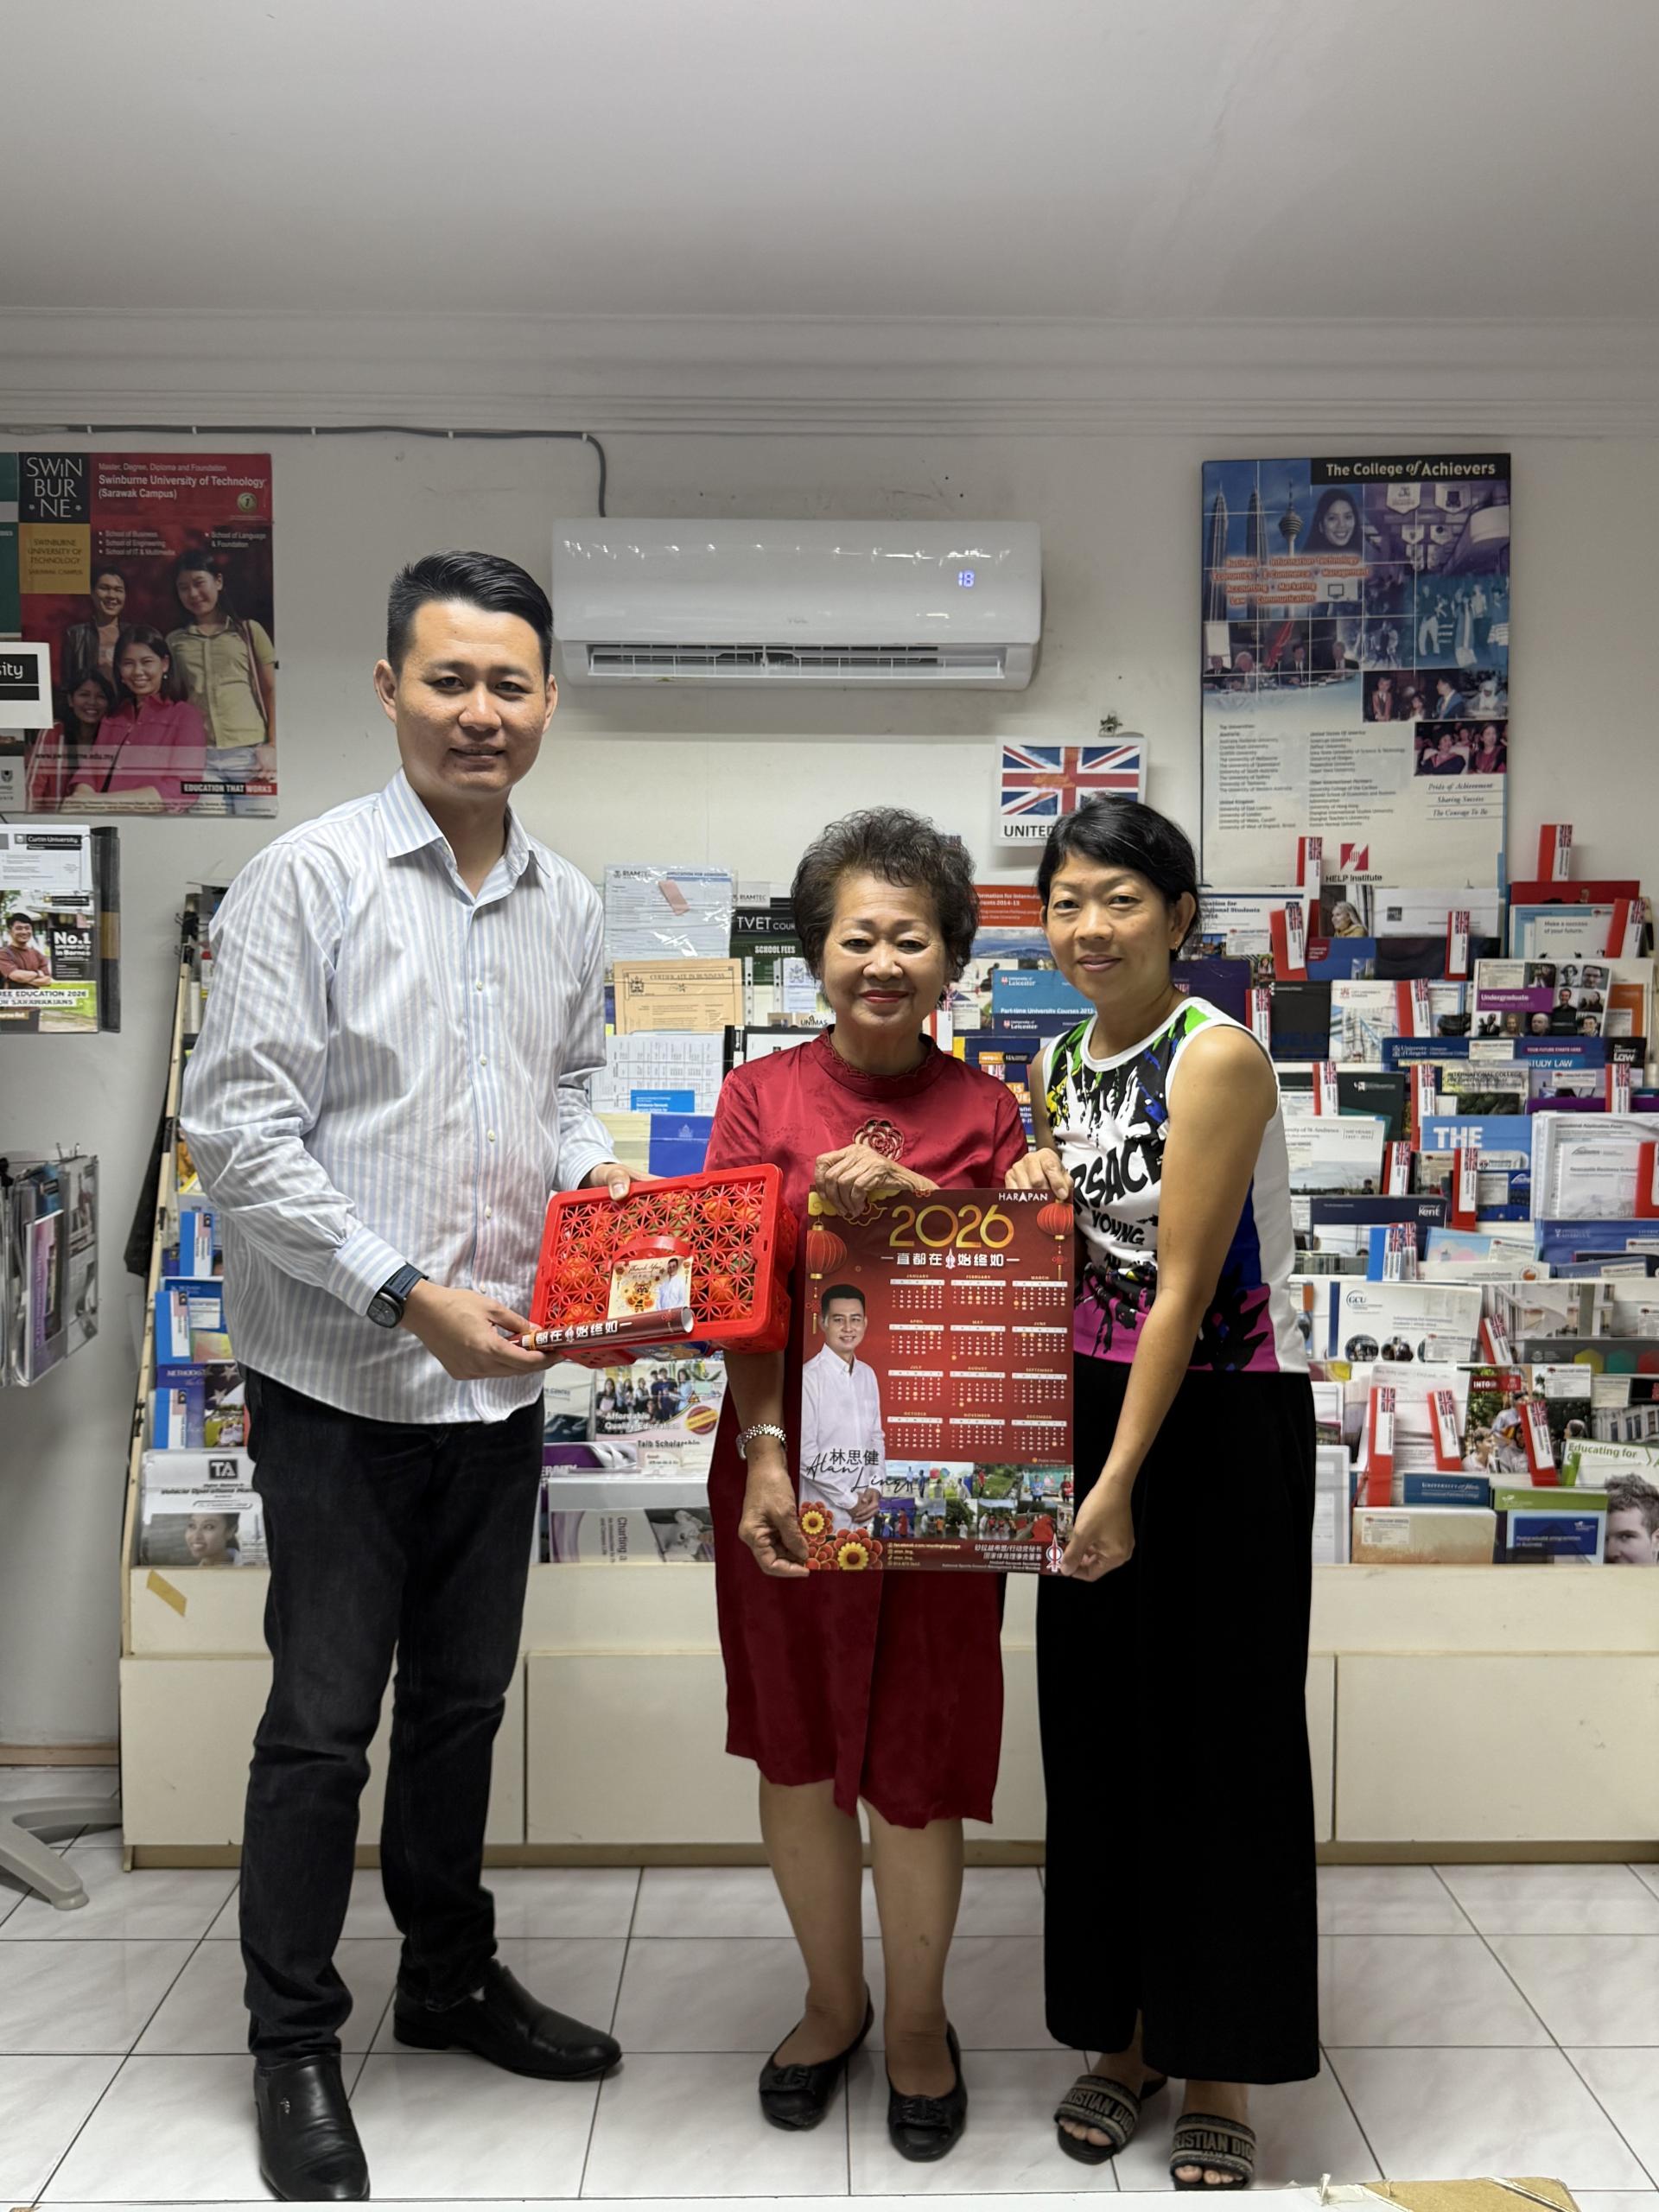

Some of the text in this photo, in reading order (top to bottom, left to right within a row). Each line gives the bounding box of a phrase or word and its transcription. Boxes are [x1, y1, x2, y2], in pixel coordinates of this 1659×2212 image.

[1326, 460, 1496, 476] The College of Achievers
[99, 474, 264, 488] Swinburne University of Technology
[35, 479, 77, 498] BUR
[99, 488, 176, 500] (Sarawak Campus)
[41, 499, 71, 517] NE
[34, 538, 76, 547] SWINBURNE
[30, 556, 79, 565] TECHNOLOGY
[958, 571, 975, 587] 18
[184, 784, 272, 793] EDUCATION THAT WORKS
[1004, 824, 1054, 837] UNITED
[1351, 874, 1382, 882] Institute
[737, 916, 772, 931] TVET
[54, 931, 92, 944] No.1
[754, 945, 796, 954] SCHOOL FEES
[1481, 994, 1529, 1002] Undergraduate
[1554, 1059, 1573, 1068] LAW
[1433, 1126, 1483, 1148] THE
[998, 1192, 1048, 1202] HARAPAN
[1419, 1208, 1440, 1217] Kent
[889, 1205, 1014, 1249] 2026
[605, 1412, 650, 1421] Affordable
[638, 1439, 654, 1449] Taib
[1568, 1442, 1637, 1458] Educating for
[829, 1448, 880, 1466] 林思健
[211, 1462, 236, 1477] TA
[806, 1452, 908, 1494] Alan Ling
[616, 1516, 628, 1553] Charting
